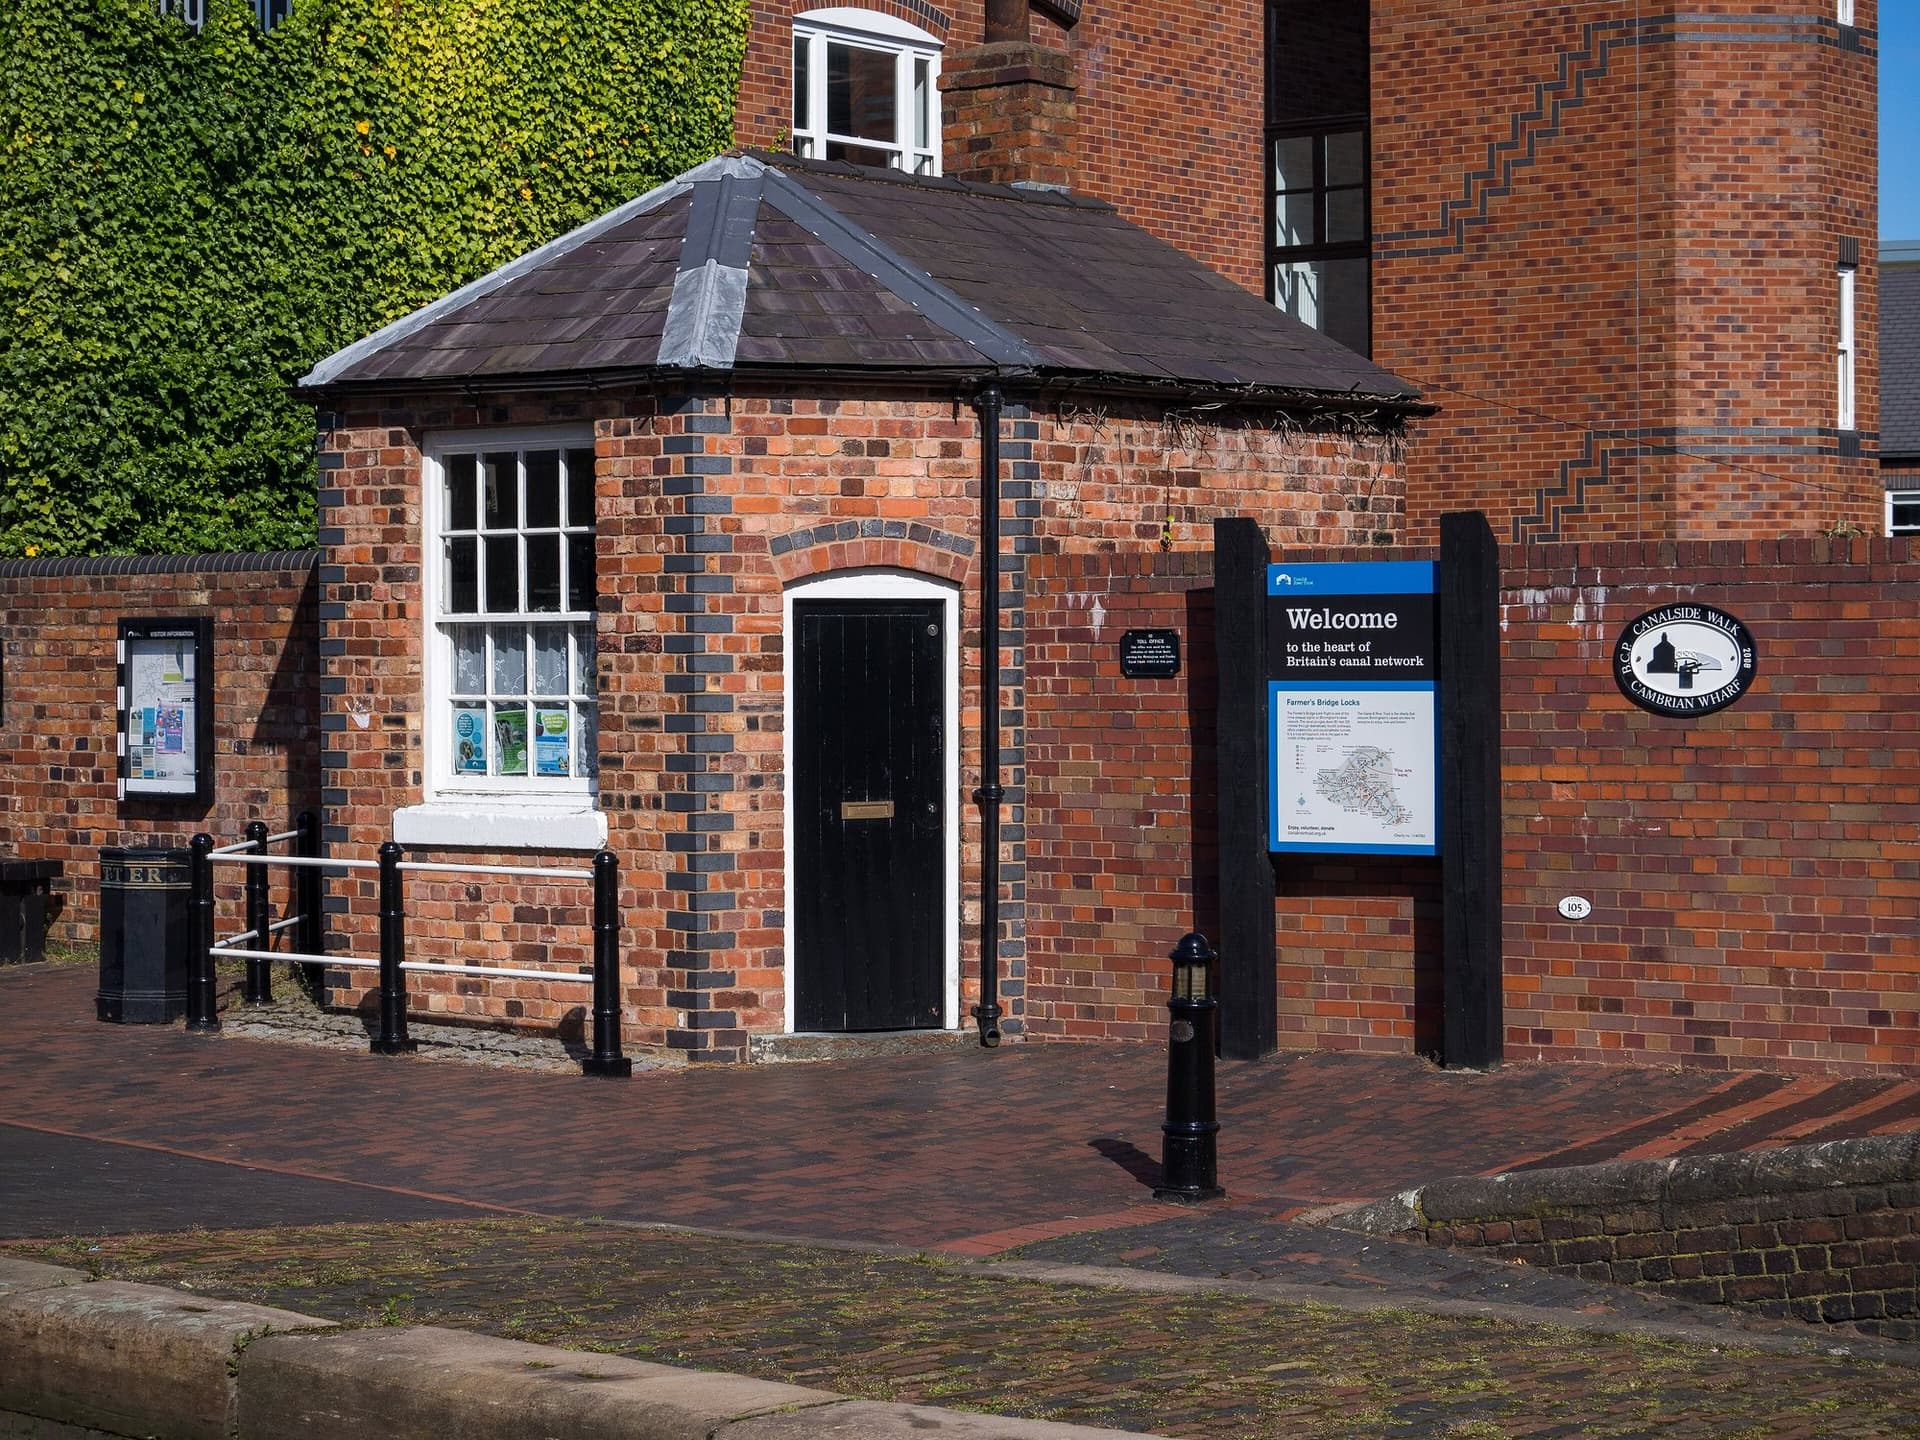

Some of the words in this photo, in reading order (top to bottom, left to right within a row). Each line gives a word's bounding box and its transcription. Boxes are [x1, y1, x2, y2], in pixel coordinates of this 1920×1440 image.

[1286, 608, 1398, 629] Welcome
[1633, 607, 1701, 636] CANALSIDE
[1707, 610, 1741, 637] WALK
[1286, 642, 1298, 652] to
[1302, 641, 1321, 652] the
[1324, 641, 1355, 652] heart
[1358, 641, 1371, 652] of
[1286, 656, 1336, 667] Britain's
[1339, 656, 1371, 666] canal
[1374, 655, 1424, 666] network
[1743, 647, 1752, 669] 2008
[1631, 680, 1695, 710] CAMBRIAN
[1697, 678, 1742, 709] WHARF
[1317, 699, 1339, 707] Bridge
[1568, 903, 1582, 912] 105
